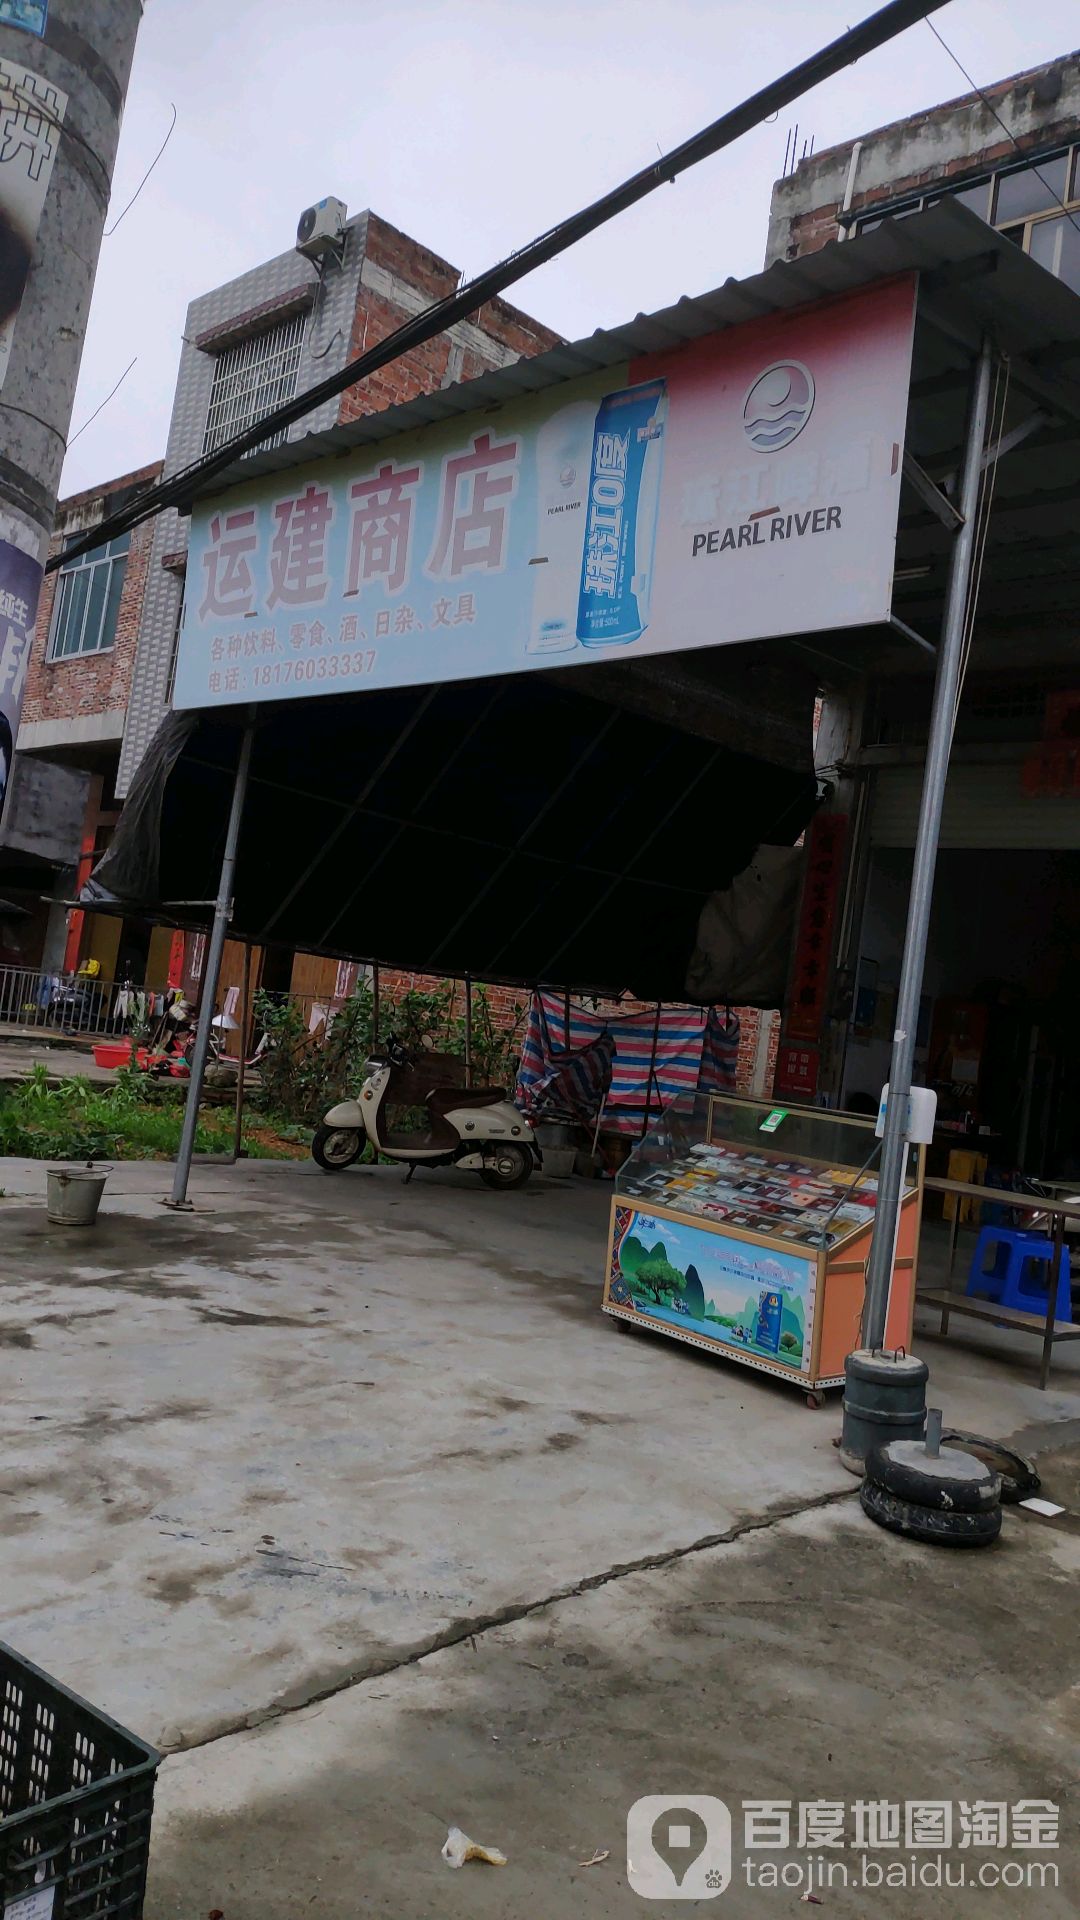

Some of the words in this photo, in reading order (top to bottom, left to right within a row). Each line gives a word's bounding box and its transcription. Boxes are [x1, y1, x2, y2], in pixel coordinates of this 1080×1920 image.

[200, 432, 517, 622] 运建商店
[692, 521, 766, 557] PEARL
[769, 505, 842, 542] RIVER
[211, 593, 476, 662] 各种饮料、零食、酒、日杂、文具
